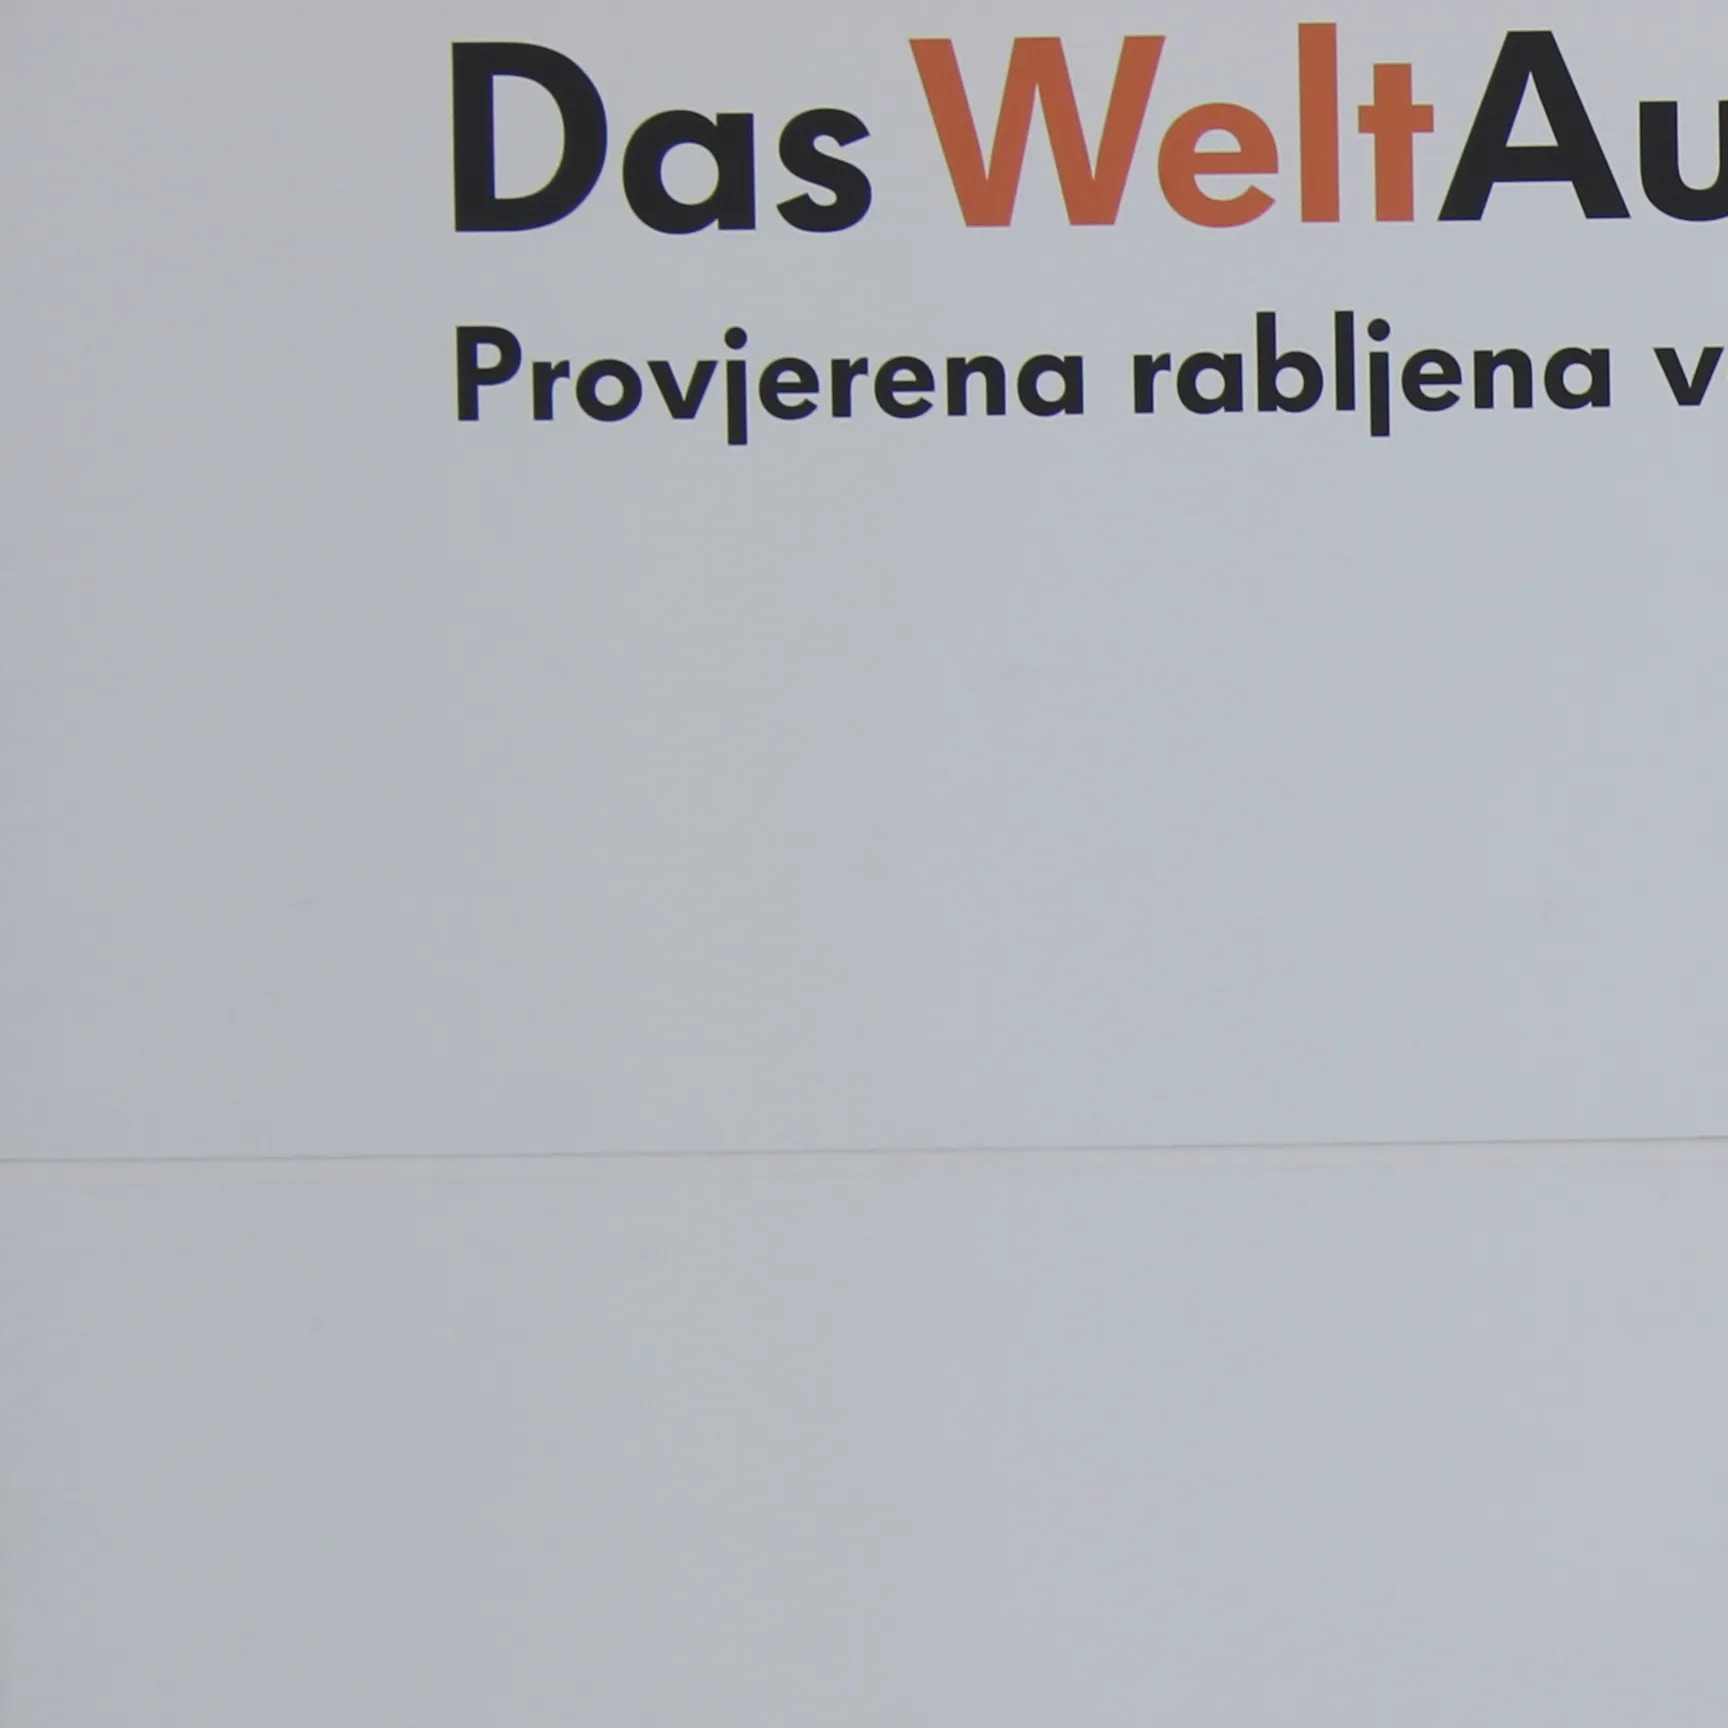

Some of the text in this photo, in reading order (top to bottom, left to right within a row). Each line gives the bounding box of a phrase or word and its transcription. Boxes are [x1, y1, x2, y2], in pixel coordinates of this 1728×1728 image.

[451, 41, 873, 236] Das
[455, 325, 1084, 446] Provjerena
[1133, 310, 1611, 438] rabljena
